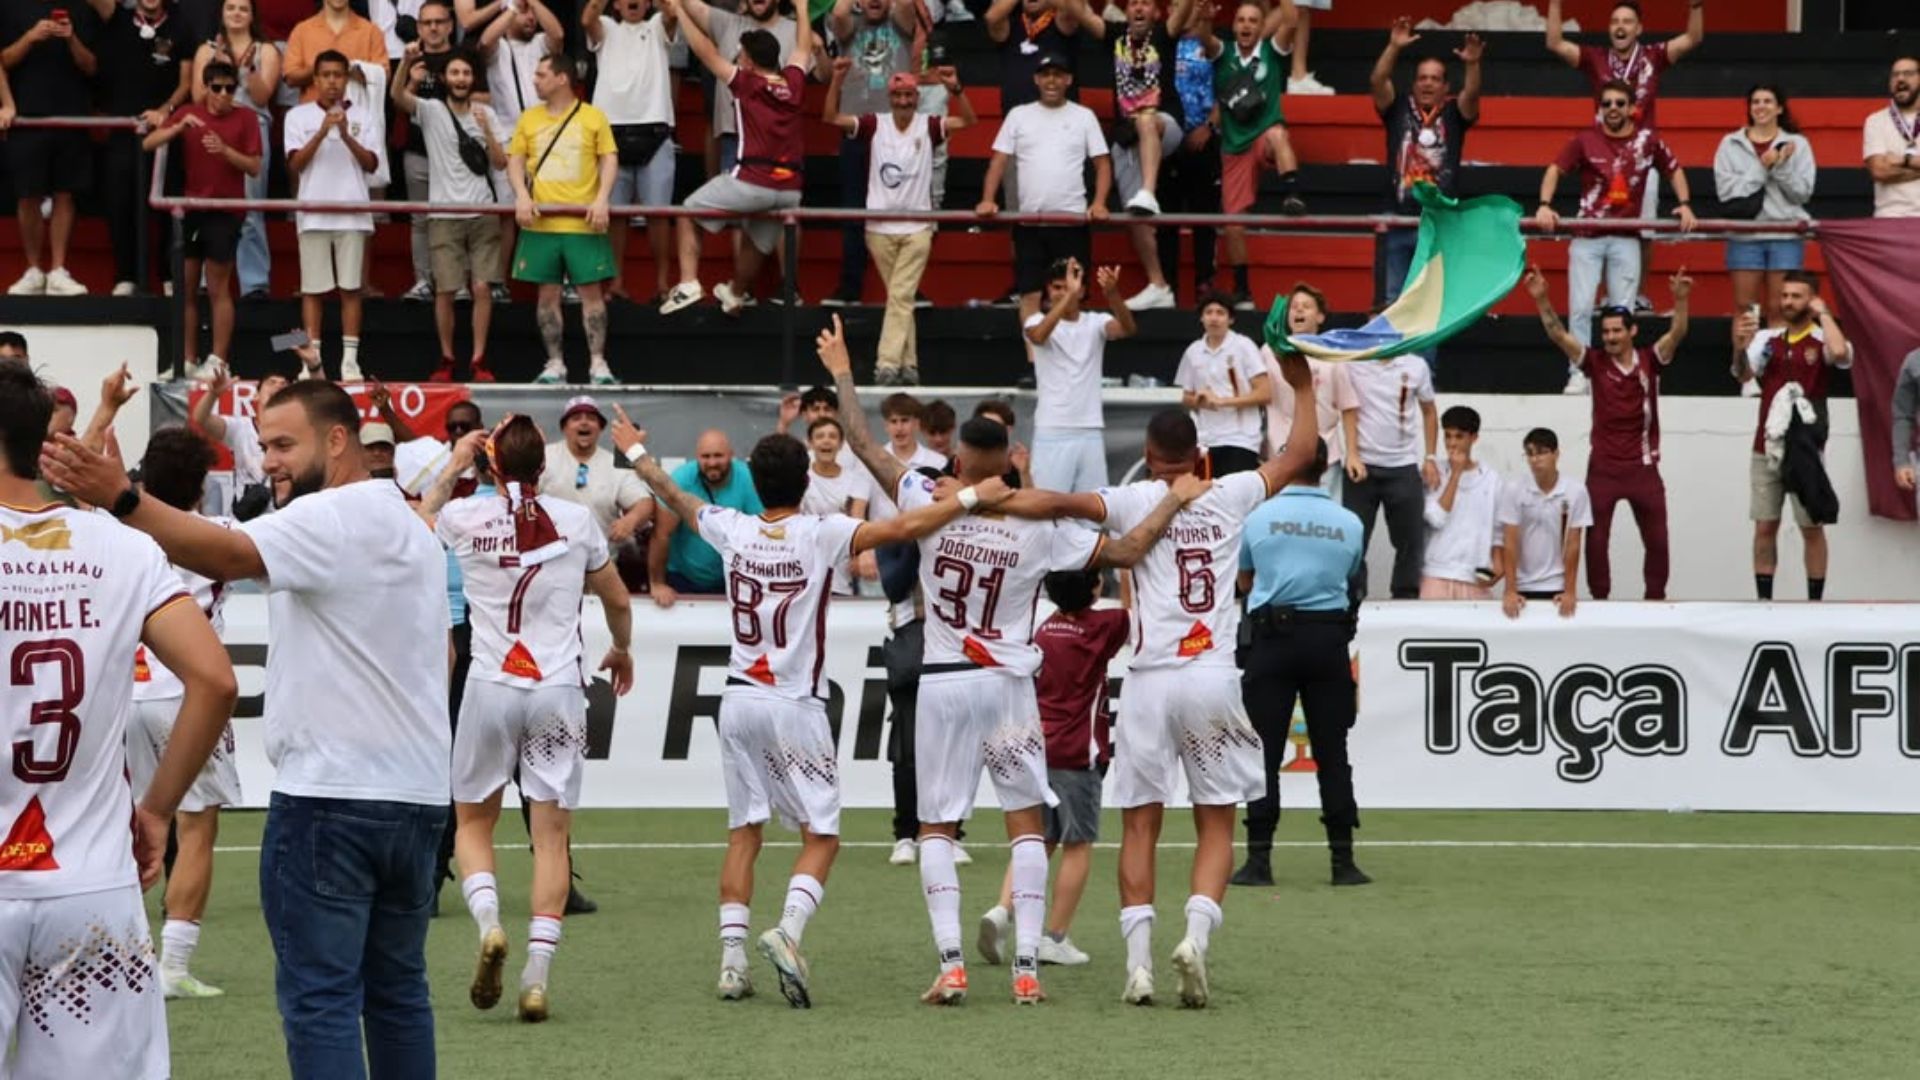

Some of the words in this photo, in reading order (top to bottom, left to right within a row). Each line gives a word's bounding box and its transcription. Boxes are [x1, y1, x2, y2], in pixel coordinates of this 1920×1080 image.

[746, 559, 804, 578] MARTINS
[1269, 521, 1345, 542] POLÍCIA
[79, 597, 100, 629] E.
[499, 555, 543, 634] 7
[730, 570, 808, 648] 87
[933, 555, 1006, 640] 31
[1175, 548, 1216, 613] 6
[11, 639, 84, 784] 3
[1398, 638, 1688, 783] Taça
